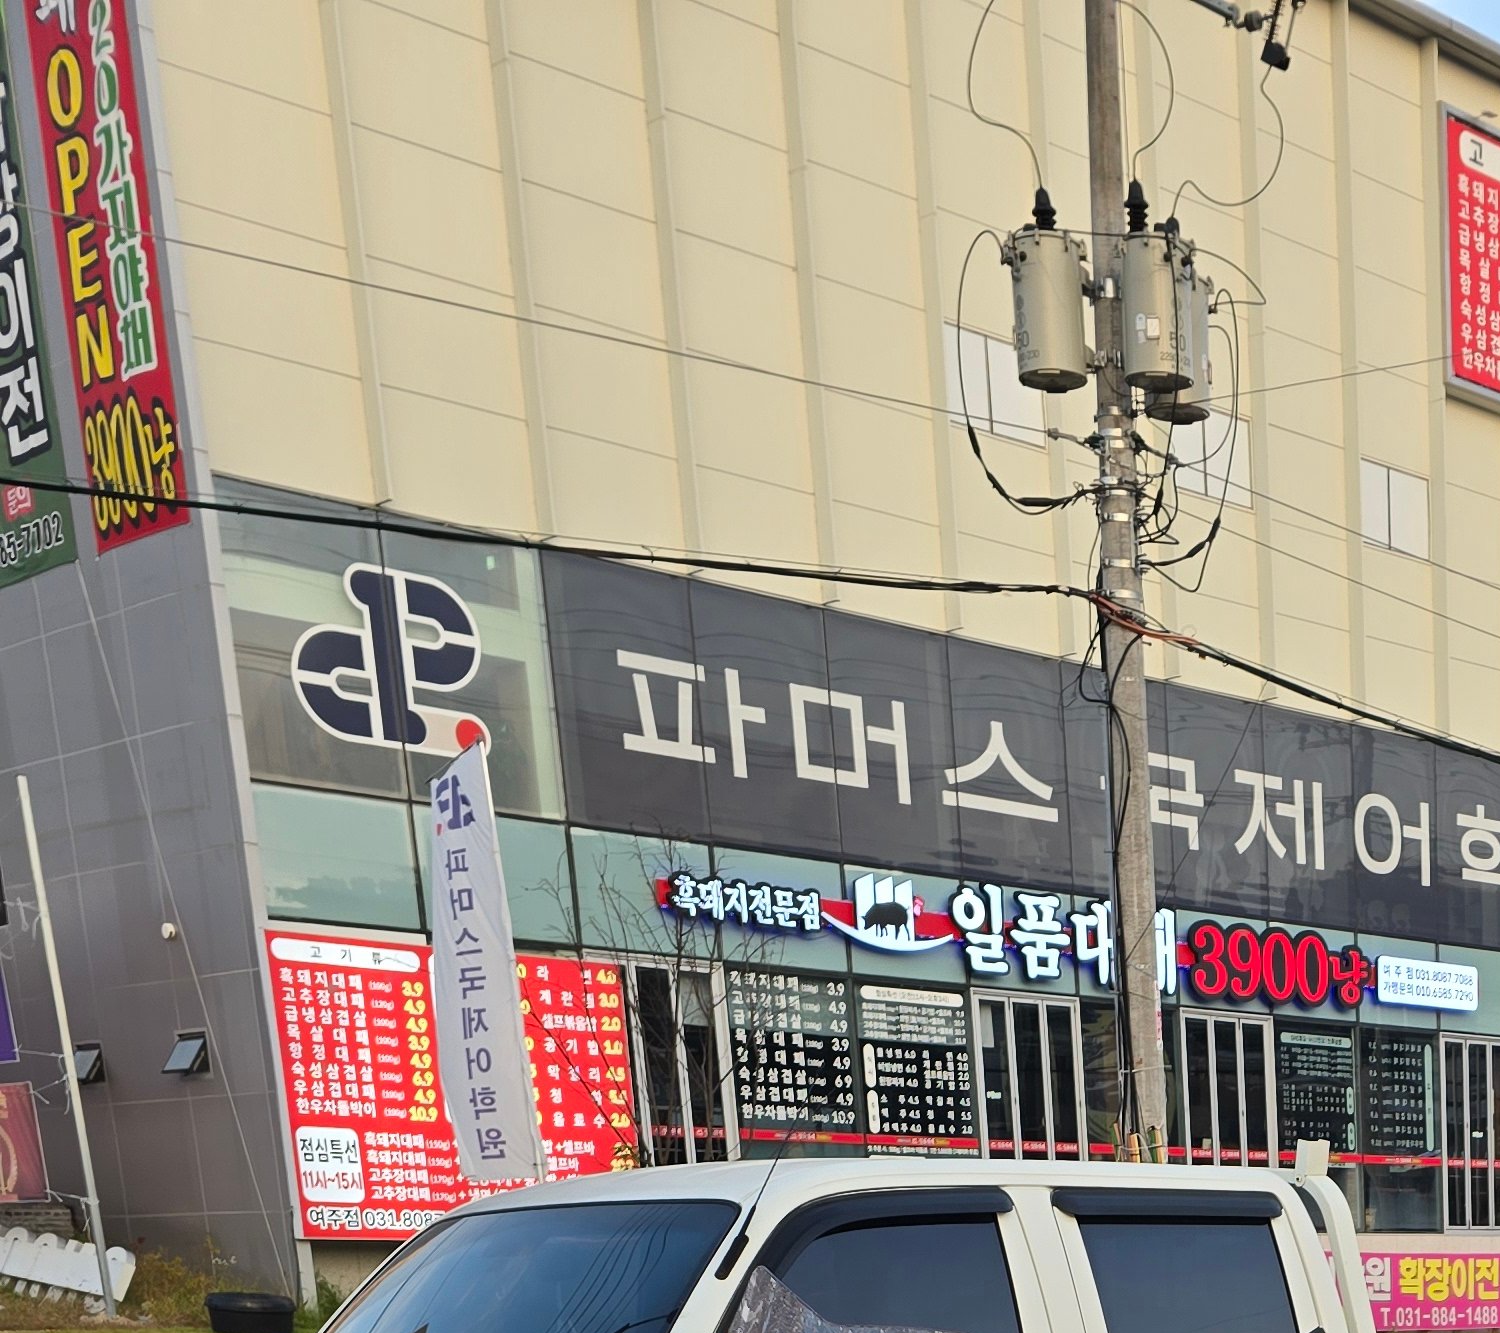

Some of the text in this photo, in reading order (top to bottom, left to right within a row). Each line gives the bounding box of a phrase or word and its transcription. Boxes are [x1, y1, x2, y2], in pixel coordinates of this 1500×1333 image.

[47, 48, 116, 390] OPEN
[672, 872, 822, 931] 흑돼지전문점
[1191, 922, 1370, 1008] 3900냥
[279, 966, 424, 998] 흑돼지대패 3.9
[826, 982, 845, 997] 3.9
[282, 986, 426, 1016] 고추장대패 4.9
[828, 1001, 847, 1015] 4.9
[405, 1016, 429, 1033] 4.9
[600, 1016, 622, 1031] 2.0
[829, 1020, 848, 1033] 4.9
[407, 1034, 431, 1051] 3.9
[603, 1039, 624, 1055] 1.0
[831, 1038, 850, 1052] 3.9
[409, 1052, 433, 1069] 4.9
[832, 1056, 851, 1070] 4.9
[291, 1060, 435, 1087] 숙성삼겹살 6.9
[293, 1079, 437, 1105] 우삼겹대패 4.9
[836, 1093, 854, 1106] 4.9
[296, 1097, 439, 1122] 한우차돌박이 10.9
[832, 1111, 856, 1125] 10.9
[610, 1112, 631, 1128] 2.0
[364, 1131, 425, 1149] 흑돼지대패
[300, 1137, 359, 1164] 점심특선
[366, 1149, 427, 1167] 흑돼지대패
[302, 1170, 363, 1191] 11시~15시
[368, 1167, 429, 1185] 고추장대패
[371, 1186, 431, 1202] 고추장대패
[309, 1208, 361, 1229] 여주점
[1398, 1257, 1500, 1302] 확장이전
[1380, 1305, 1499, 1328] T.031-884-1488
